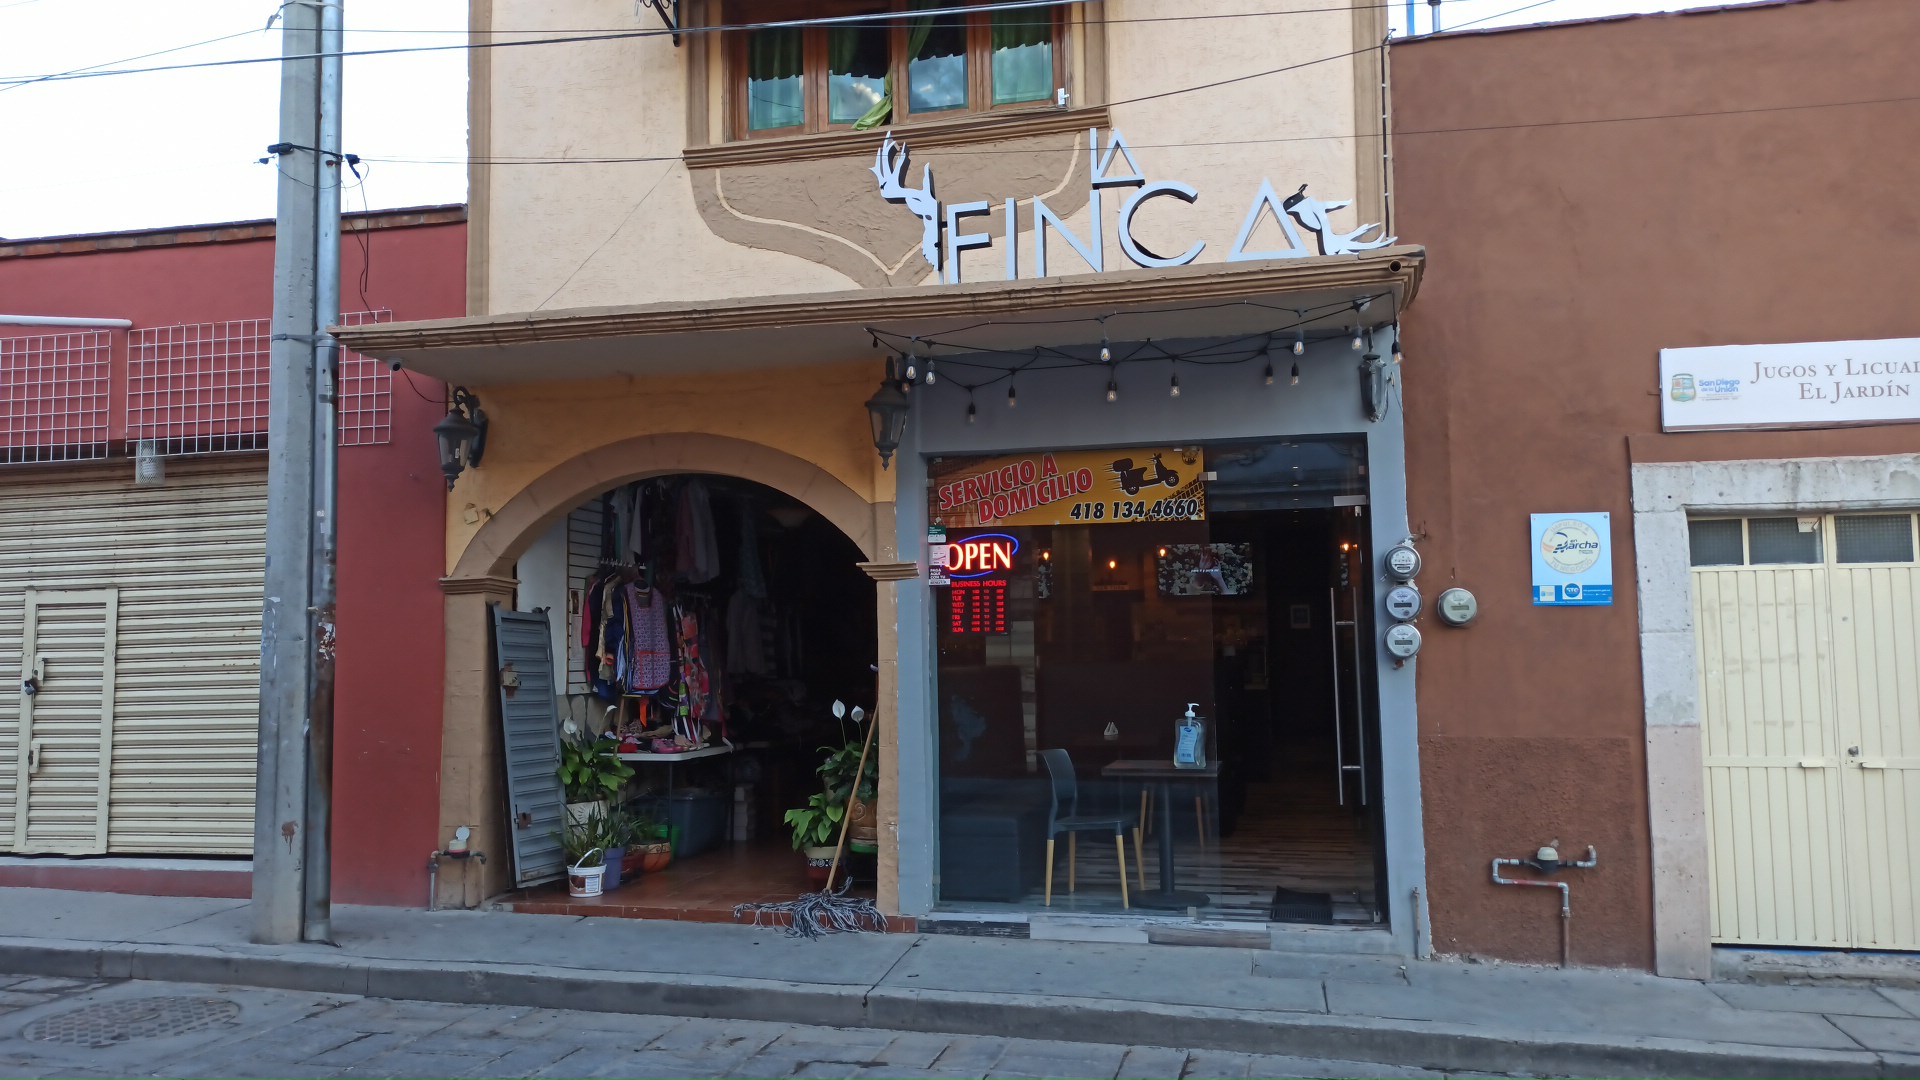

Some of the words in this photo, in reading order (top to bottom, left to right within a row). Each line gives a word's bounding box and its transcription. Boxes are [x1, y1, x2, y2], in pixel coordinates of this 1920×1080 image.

[1090, 127, 1145, 188] LA
[946, 178, 1310, 284] FINCA
[1698, 379, 1715, 387] San
[1716, 378, 1740, 388] Diego
[1750, 361, 1817, 384] JUGOS
[1824, 364, 1838, 377] Y
[1798, 382, 1827, 400] EL
[1830, 379, 1911, 404] JARDÍN
[938, 459, 1037, 510] SERVICIO
[1041, 453, 1059, 478] A
[978, 467, 1094, 524] DOMICILIO
[1070, 502, 1105, 520] 418
[1112, 500, 1146, 520] 134
[1150, 498, 1199, 518] 4660
[946, 542, 1011, 571] OPEN
[951, 580, 981, 588] BUSINESS
[983, 579, 1007, 588] HOURS
